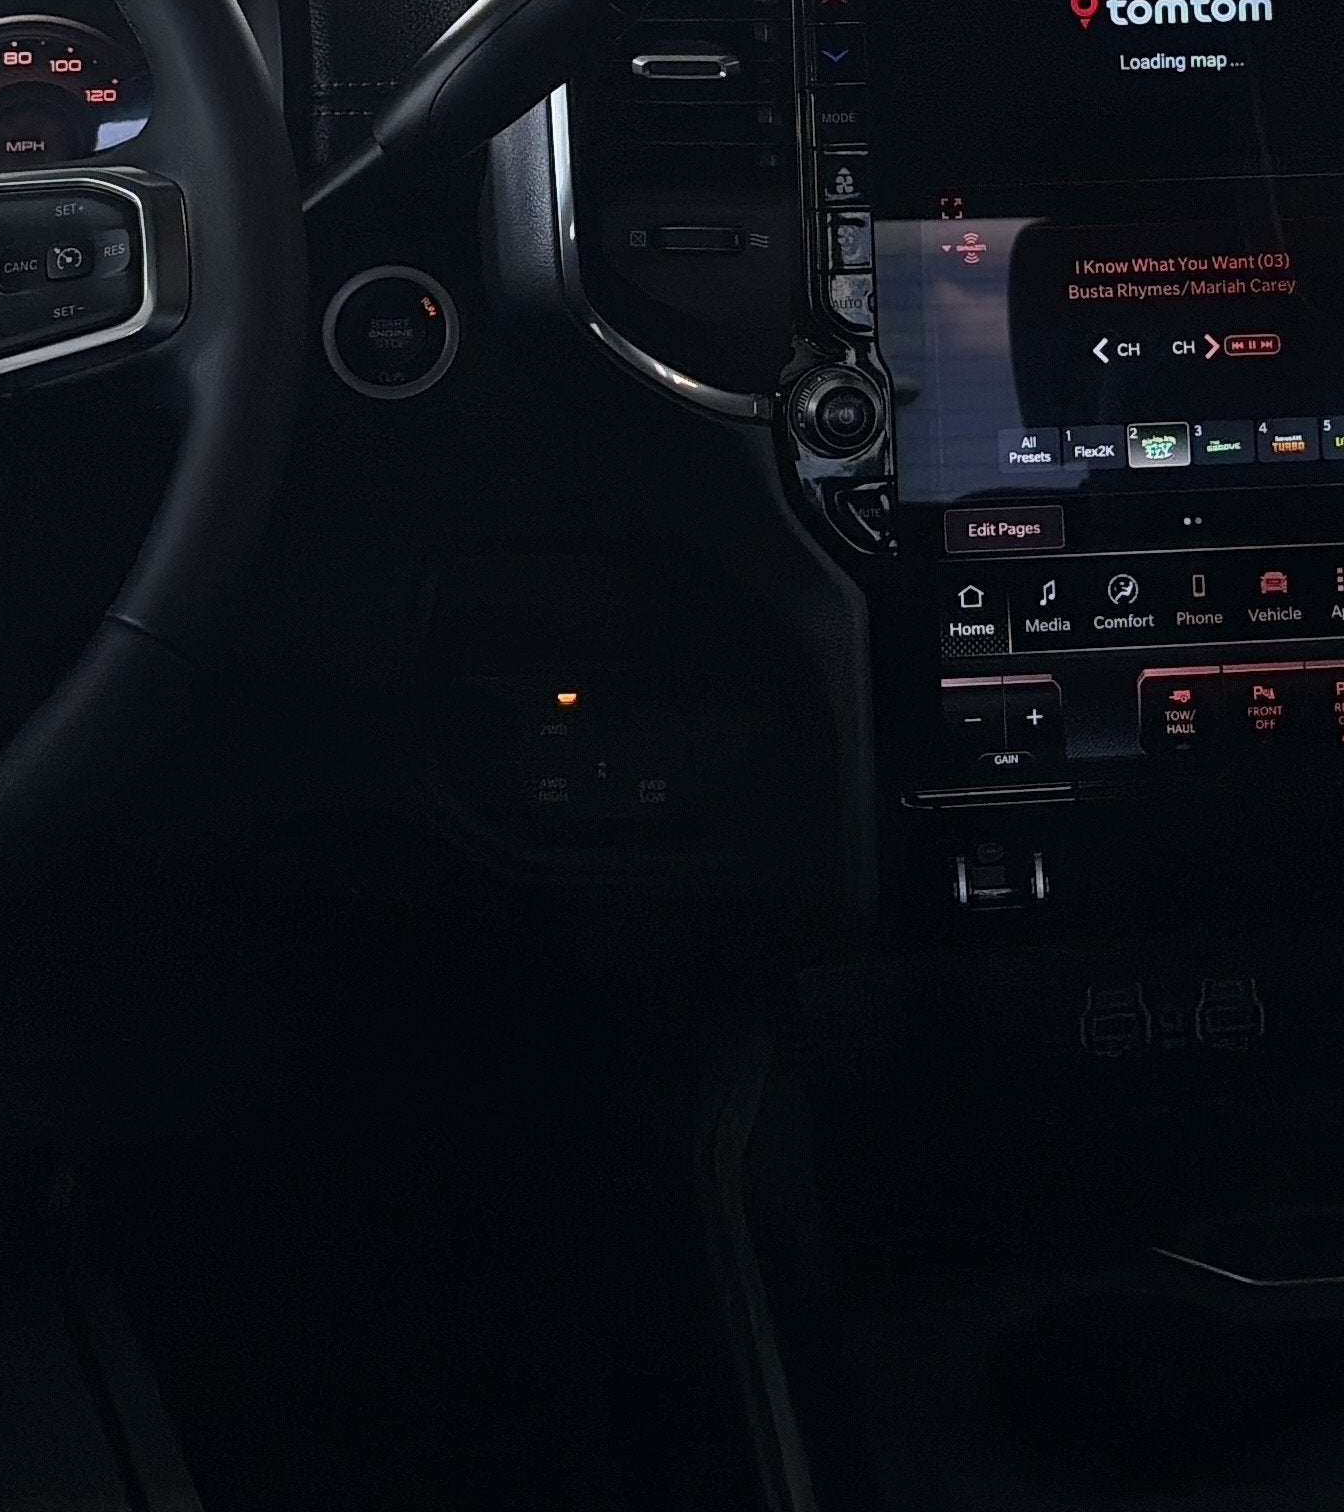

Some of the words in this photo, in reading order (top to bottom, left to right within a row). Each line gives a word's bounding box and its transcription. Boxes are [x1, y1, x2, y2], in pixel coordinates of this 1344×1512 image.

[3, 50, 33, 66] 80
[49, 58, 83, 73] 100
[1119, 52, 1187, 73] Loading
[1190, 54, 1228, 72] map
[85, 88, 118, 104] 120
[821, 112, 857, 124] MODE
[5, 139, 46, 153] MPH
[103, 242, 127, 258] RES
[2, 258, 39, 275] CANC
[1082, 259, 1130, 275] Know
[1131, 257, 1176, 273] What
[1177, 256, 1209, 272] You
[1212, 254, 1256, 271] Want
[1256, 252, 1291, 270] (03)
[1068, 283, 1114, 300] Busta
[1116, 279, 1247, 301] Rhymes/Mariah
[1250, 277, 1297, 295] Carey
[832, 298, 863, 310] AUTO
[1117, 342, 1141, 357] CH
[1172, 340, 1196, 355] CH
[1129, 427, 1139, 439] 2
[1193, 424, 1203, 437] 3
[1258, 422, 1268, 434] 4
[1323, 419, 1332, 432] 5
[1065, 429, 1072, 441] 1
[1021, 436, 1037, 450] All
[1272, 441, 1306, 453] TURBO
[1009, 451, 1052, 465] Presets
[1074, 444, 1116, 459] Flex2K
[967, 522, 997, 538] Edit
[998, 522, 1042, 539] Pages
[1176, 610, 1224, 626] Phone
[1247, 605, 1303, 623] Vehicle
[949, 621, 996, 637] Home
[1024, 617, 1072, 634] Media
[1093, 614, 1156, 631] Comfort
[1164, 708, 1197, 723] TOW/
[1246, 704, 1284, 719] FRONT
[1165, 722, 1197, 736] HAUL
[1255, 718, 1277, 731] OFF
[993, 753, 1020, 767] GAIN
